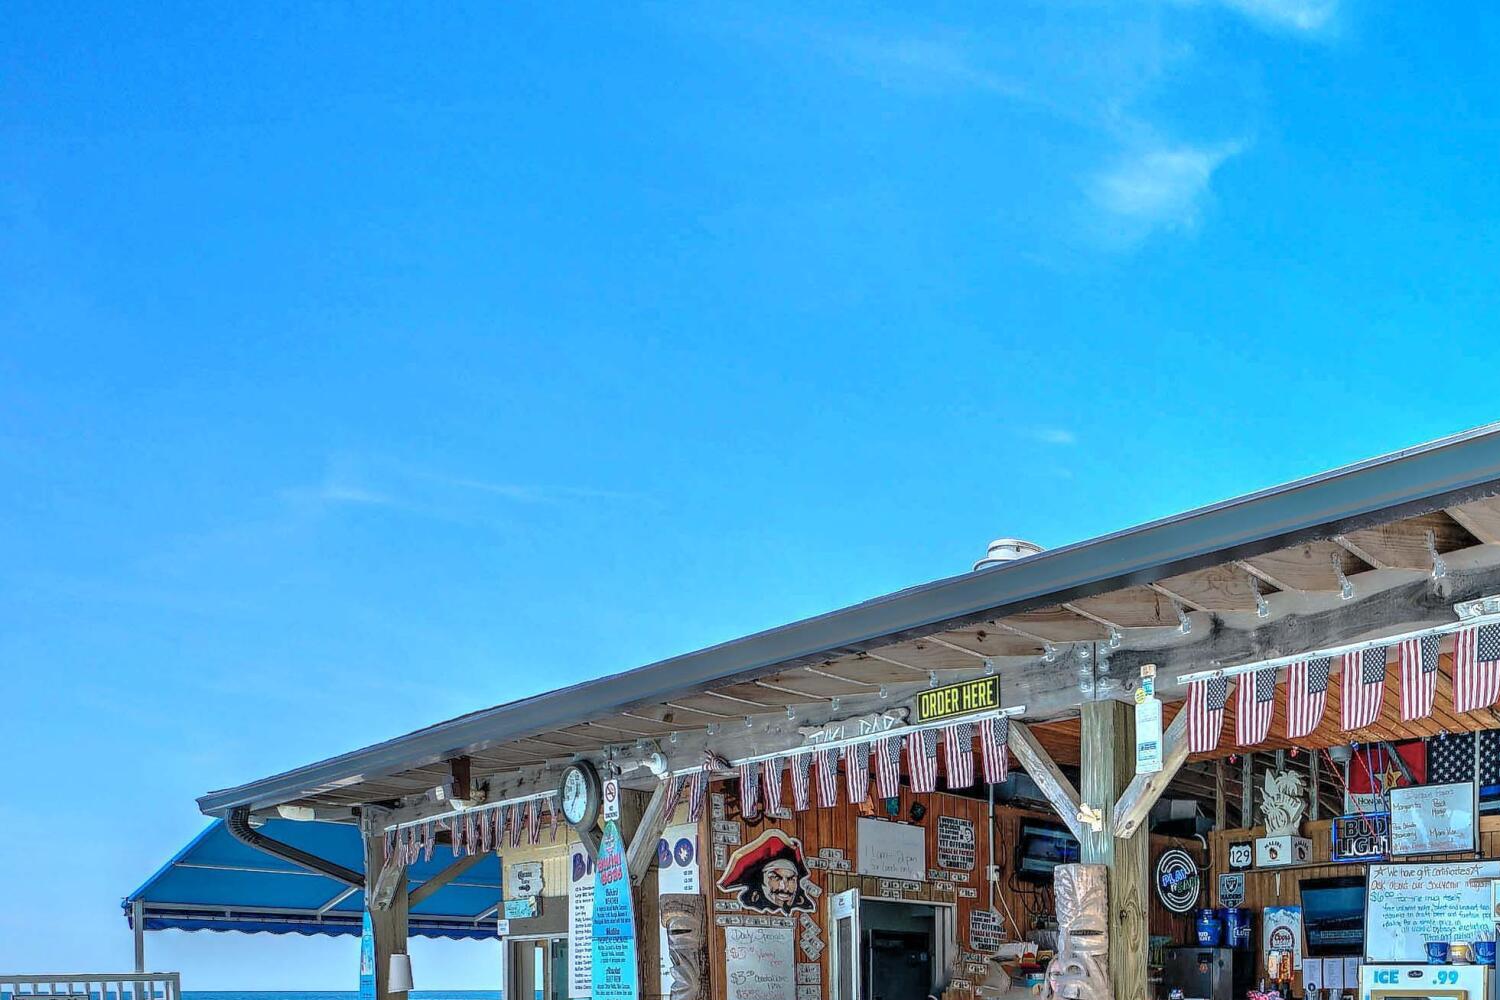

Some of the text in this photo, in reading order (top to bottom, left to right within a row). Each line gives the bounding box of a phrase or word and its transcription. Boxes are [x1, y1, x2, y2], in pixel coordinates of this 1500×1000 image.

[921, 680, 994, 718] ORDER HERE
[1345, 819, 1386, 838] BUD
[949, 840, 974, 850] OFFENDED
[1231, 850, 1250, 863] 129
[1162, 869, 1187, 887] PLAY
[1400, 868, 1415, 876] have
[1416, 865, 1430, 880] gift
[1275, 933, 1290, 941] Coors
[1373, 969, 1399, 984] ICE
[1432, 970, 1459, 985] .99
